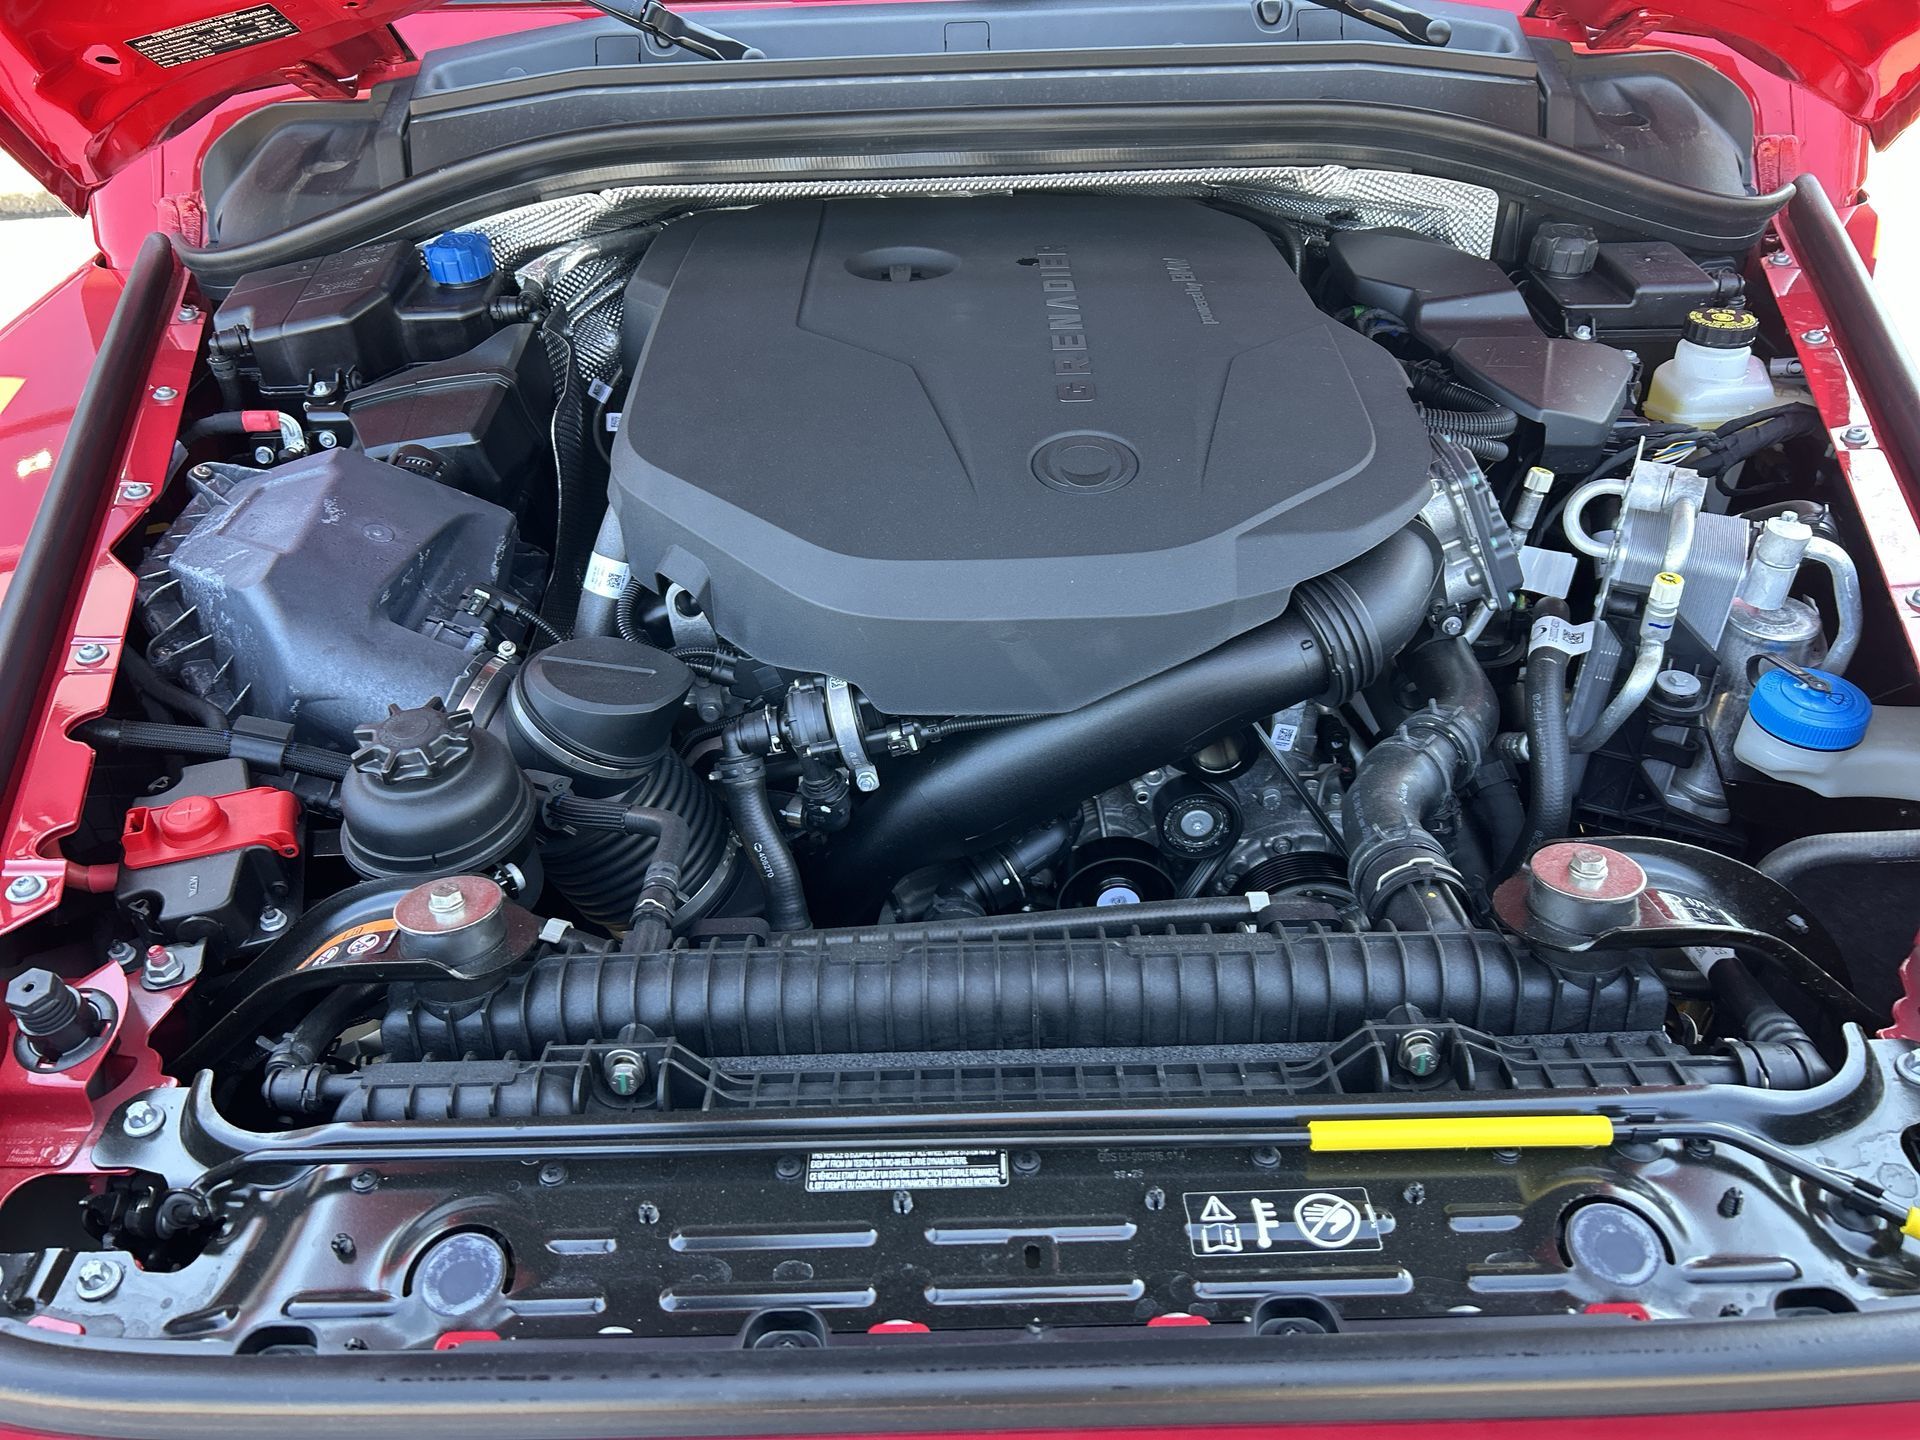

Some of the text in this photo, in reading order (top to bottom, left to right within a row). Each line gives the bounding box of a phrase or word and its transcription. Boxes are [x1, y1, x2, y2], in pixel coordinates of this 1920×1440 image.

[135, 36, 163, 46] VEHICLE
[163, 28, 194, 39] EMISSION
[194, 20, 224, 31] CONTROL
[224, 8, 270, 23] INFORMATION
[1162, 257, 1197, 282] BMW
[1191, 293, 1220, 325] powered
[1037, 246, 1096, 402] GRENADIER
[810, 1160, 830, 1168] EXEMPT
[830, 1160, 845, 1168] FROM
[854, 1159, 874, 1168] TESTING
[874, 1159, 882, 1167] ON
[882, 1158, 911, 1167] TWO-WHEEL
[912, 1158, 926, 1166] DRIVE
[926, 1156, 968, 1166] DYNAMOMETERS.
[810, 1172, 818, 1181] CE
[818, 1170, 841, 1180] VÉHICULE
[858, 1169, 876, 1180] ÉQUIPÉ
[888, 1168, 910, 1178] SYSTÈME
[910, 1170, 918, 1178] DE
[918, 1170, 942, 1178] TRACTION
[942, 1167, 970, 1178] INTÉGRALE
[814, 1182, 825, 1190] EST
[825, 1180, 847, 1190] EXEMPTÉ
[890, 1180, 900, 1188] SUR
[942, 1178, 957, 1187] DEUX
[957, 1178, 974, 1187] ROUES
